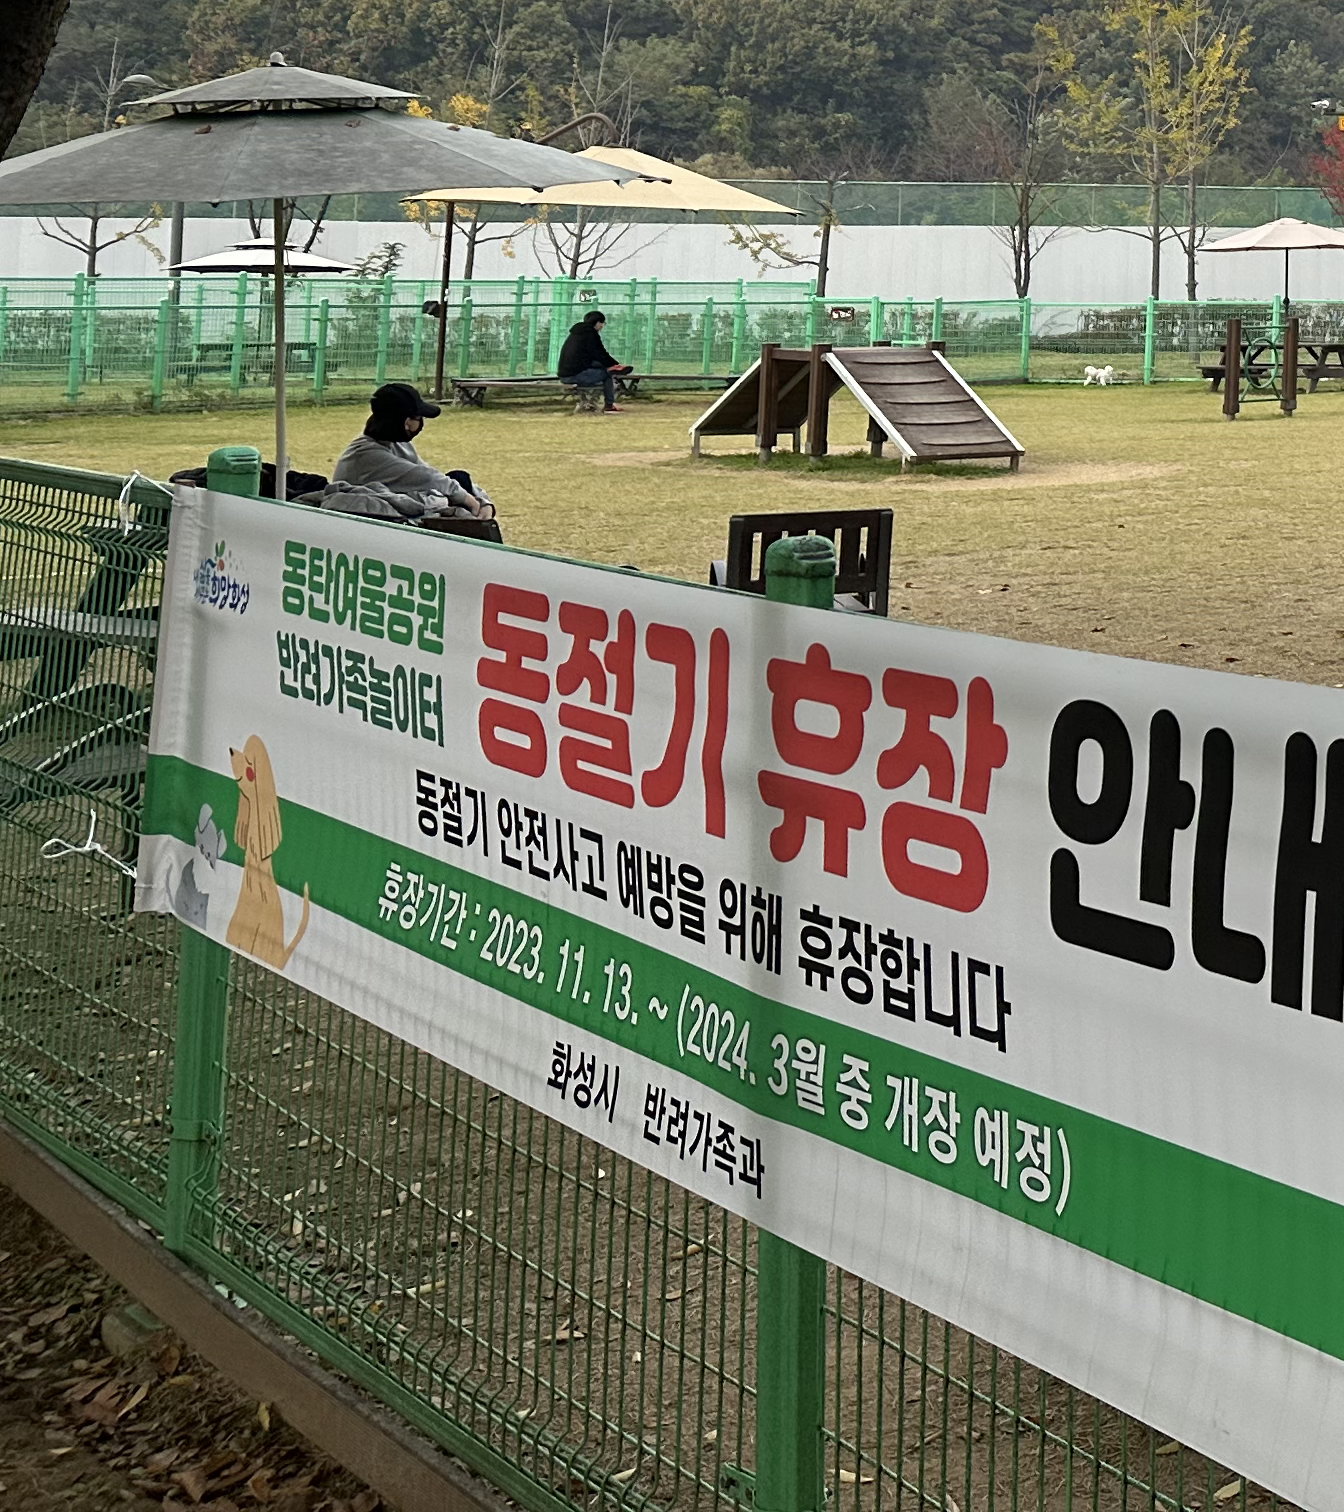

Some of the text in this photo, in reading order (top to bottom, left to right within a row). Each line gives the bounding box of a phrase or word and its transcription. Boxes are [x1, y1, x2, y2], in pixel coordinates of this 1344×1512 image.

[276, 630, 445, 748] 반려가족놀이터
[281, 539, 446, 655] 동탄여울공원
[476, 582, 730, 839] 동절기
[757, 643, 1009, 913] 휴장
[415, 768, 1012, 1054] 동절기 안전사고 예방을 위해 휴장합니다
[479, 908, 545, 984] 2023.
[556, 938, 591, 1005] 11.
[602, 957, 638, 1026] 13.
[676, 983, 757, 1086] (2024.
[767, 1034, 827, 1117] 3월
[835, 1053, 873, 1131] 중
[884, 1074, 961, 1165] 개장
[973, 1105, 1072, 1217] 예정)
[546, 1040, 766, 1201] 화성시 반려가족과
